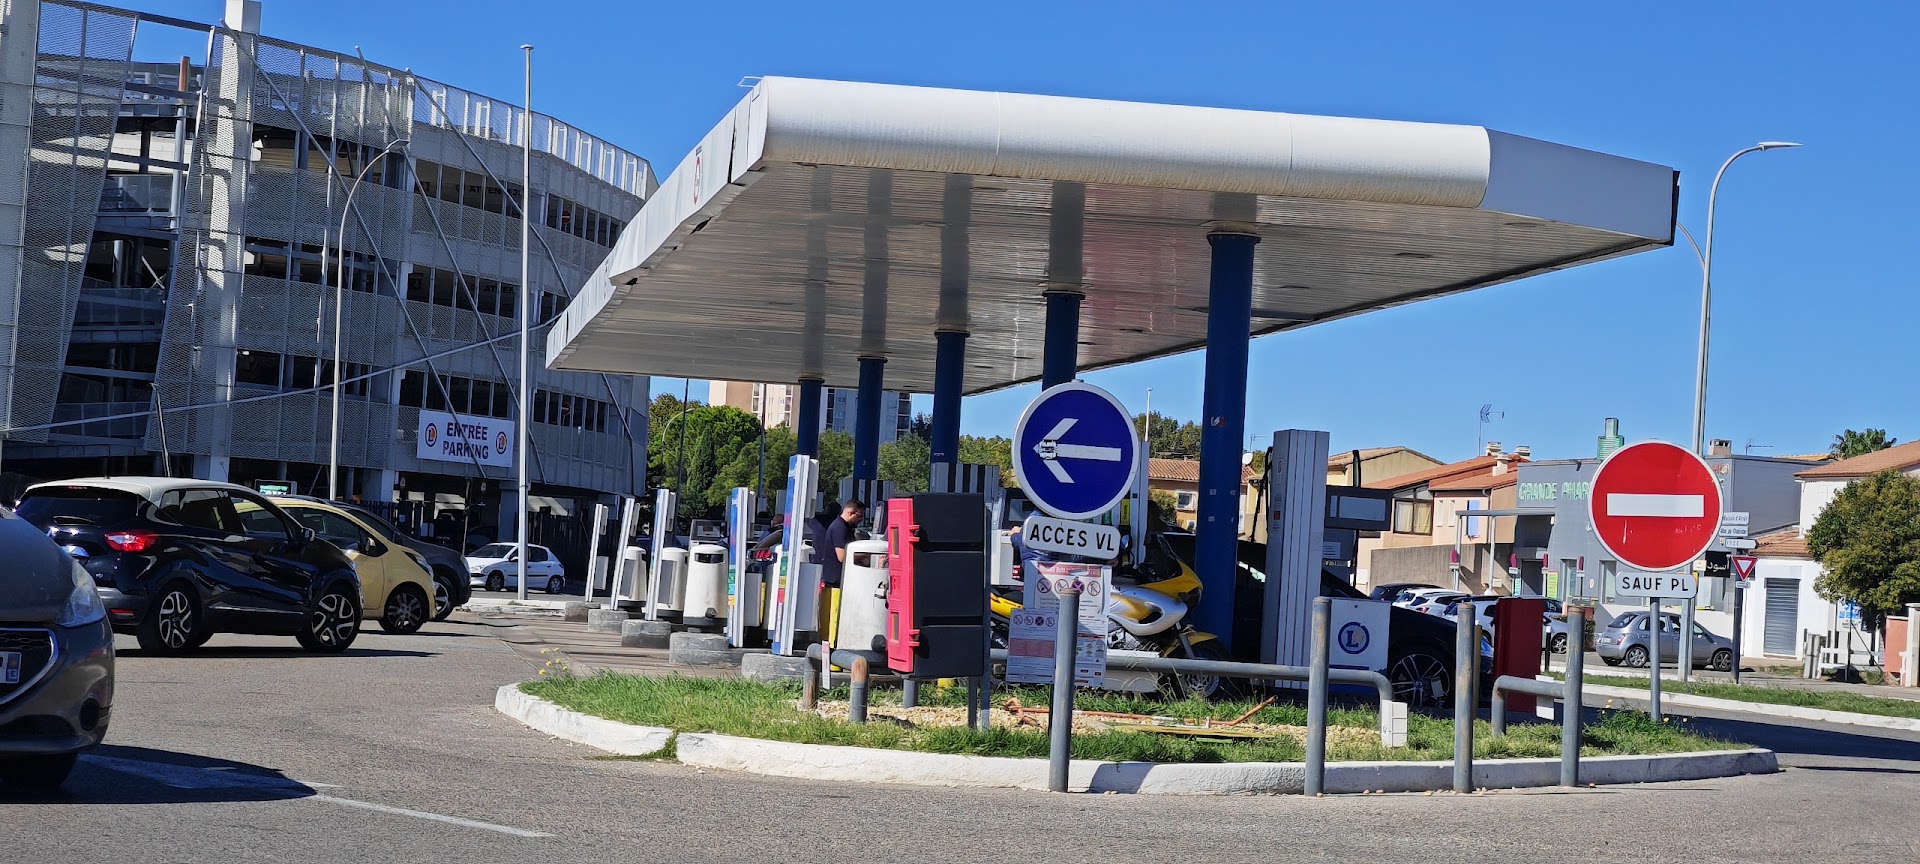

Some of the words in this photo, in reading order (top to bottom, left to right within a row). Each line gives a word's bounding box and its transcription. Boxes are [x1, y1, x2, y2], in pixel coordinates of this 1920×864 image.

[446, 422, 489, 440] ENTRÉE
[442, 441, 489, 460] PARKING
[1518, 482, 1558, 501] GRANDE
[1561, 481, 1590, 500] PHAR
[1029, 523, 1088, 547] ACCES
[1096, 532, 1115, 552] VL
[1621, 576, 1663, 591] SAUF
[1671, 577, 1689, 592] PL
